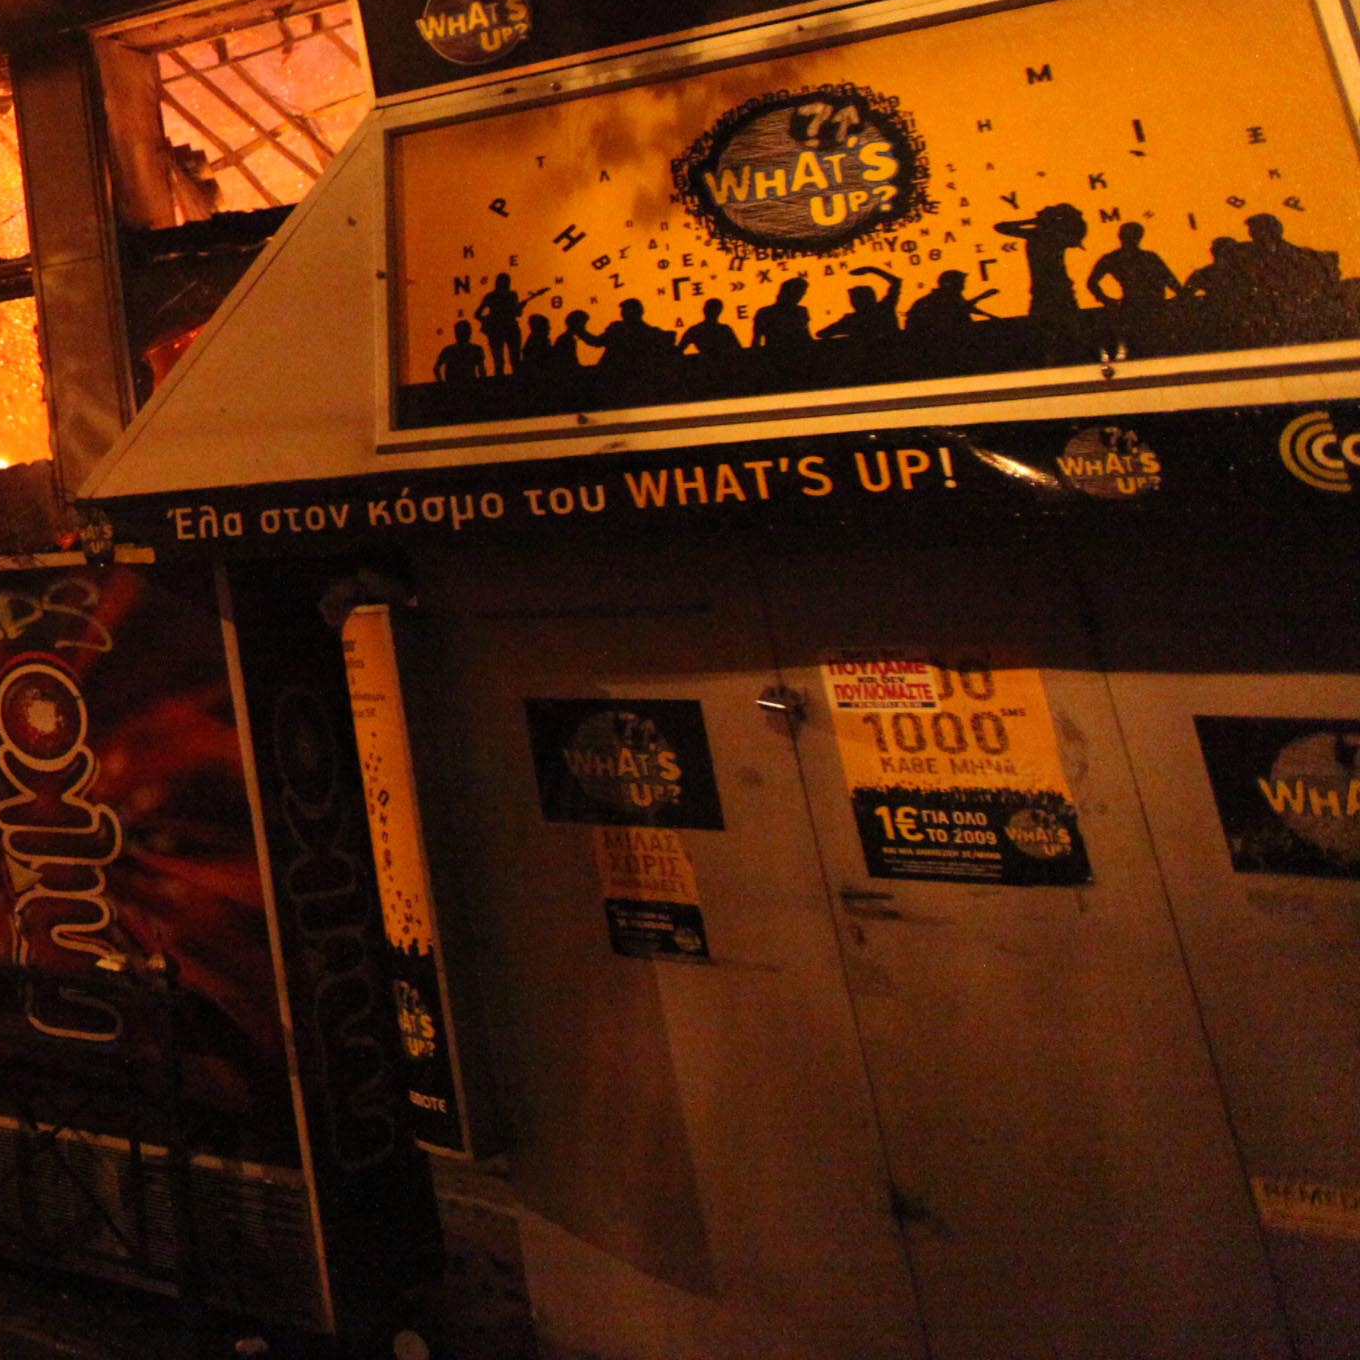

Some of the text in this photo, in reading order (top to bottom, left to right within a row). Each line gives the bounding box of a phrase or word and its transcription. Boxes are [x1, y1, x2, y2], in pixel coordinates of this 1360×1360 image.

[480, 22, 529, 53] UP?
[704, 135, 900, 206] WHAT'S
[809, 184, 898, 227] UP?
[1056, 446, 1162, 478] WHAT'S
[166, 446, 960, 540] Έλα στον κόσμο του WHAT'S UP!
[1114, 474, 1163, 495] UP?
[863, 711, 1010, 755] 1000
[881, 757, 938, 775] ΚΑΘΕ
[874, 805, 989, 842] 1€ ΓΙΑ ΟΛΟ
[926, 828, 999, 845] ΤΟ 2009
